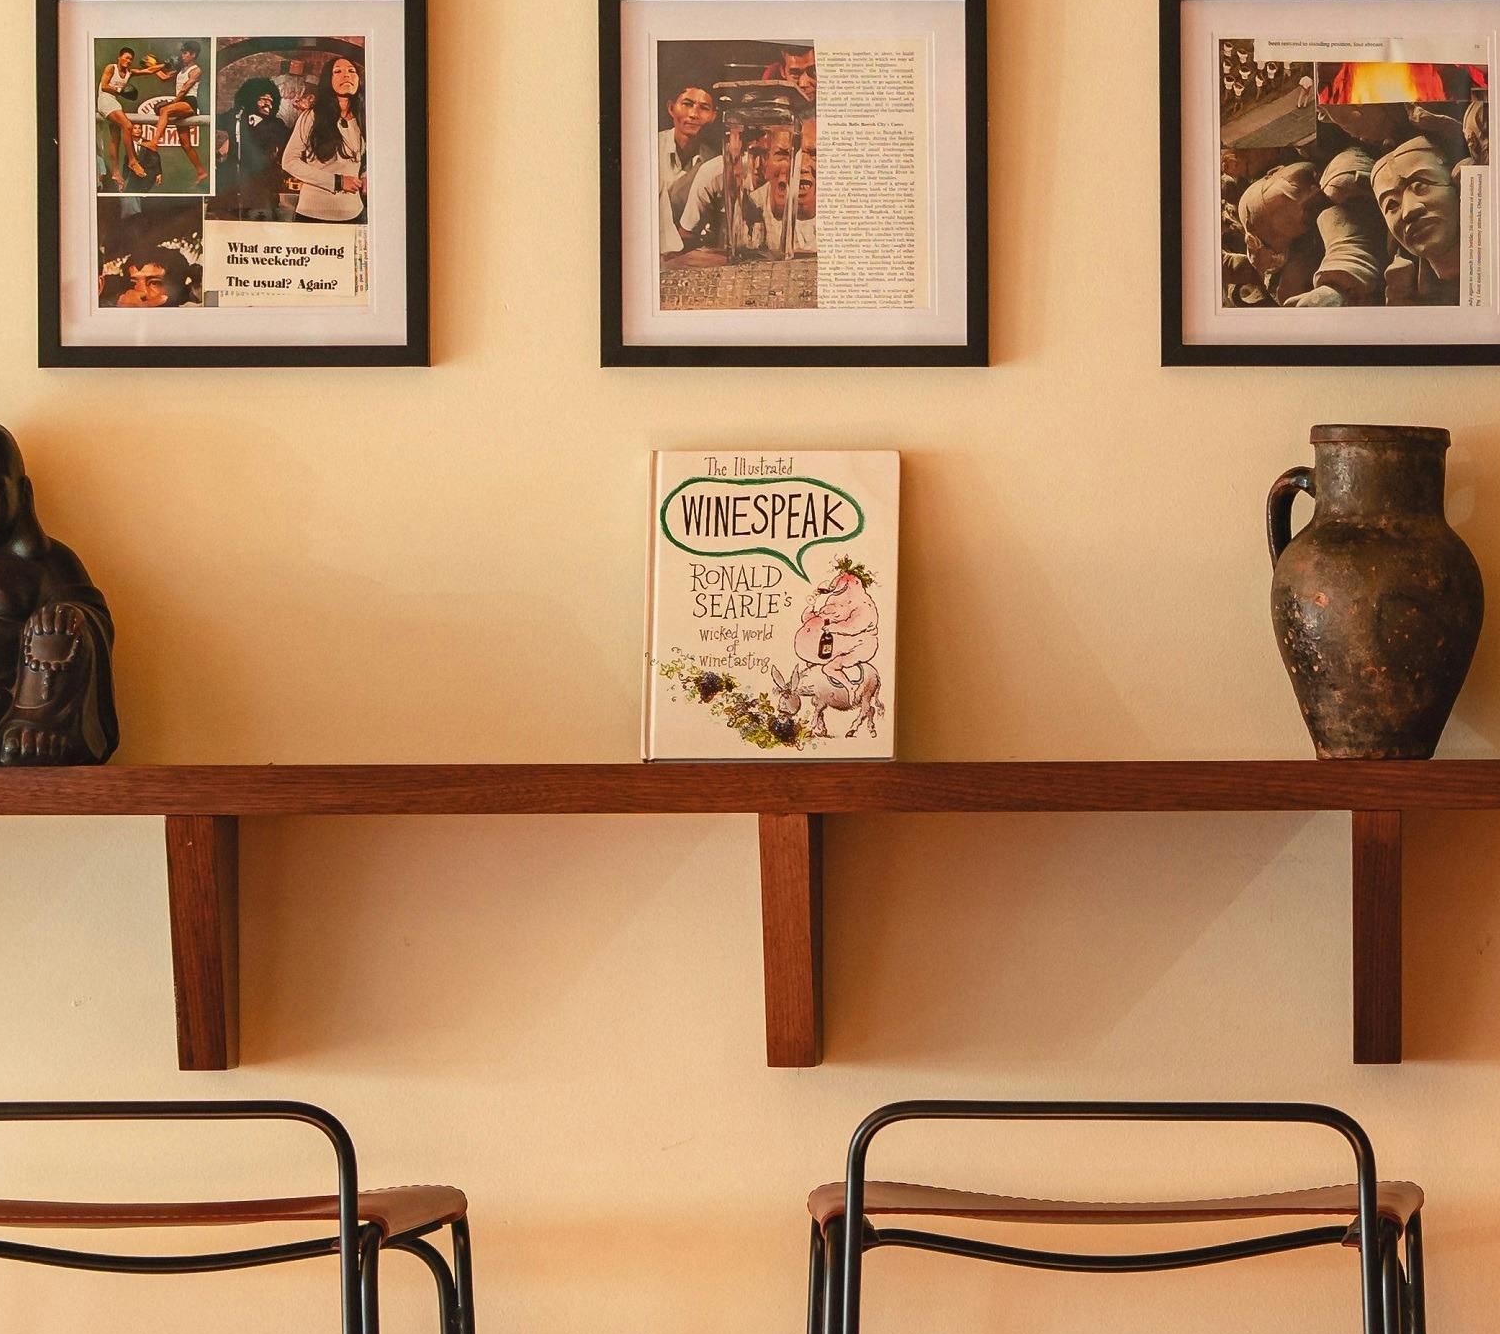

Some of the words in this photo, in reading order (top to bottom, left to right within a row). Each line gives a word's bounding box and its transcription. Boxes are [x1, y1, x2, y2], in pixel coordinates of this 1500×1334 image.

[226, 254, 249, 265] this
[251, 255, 311, 267] weekend?
[227, 242, 258, 254] What
[263, 245, 283, 254] are
[286, 246, 307, 257] you
[310, 245, 345, 260] doing
[226, 276, 250, 288] The
[253, 278, 292, 289] usual?
[297, 278, 339, 293] Again?
[703, 456, 728, 477] The
[733, 456, 794, 477] Illustrated
[681, 492, 846, 540] WINESPEAK
[689, 562, 783, 593] RONALD
[699, 624, 739, 642] wicked
[741, 623, 774, 641] world
[726, 639, 739, 655] of
[699, 652, 771, 674] winetasting
